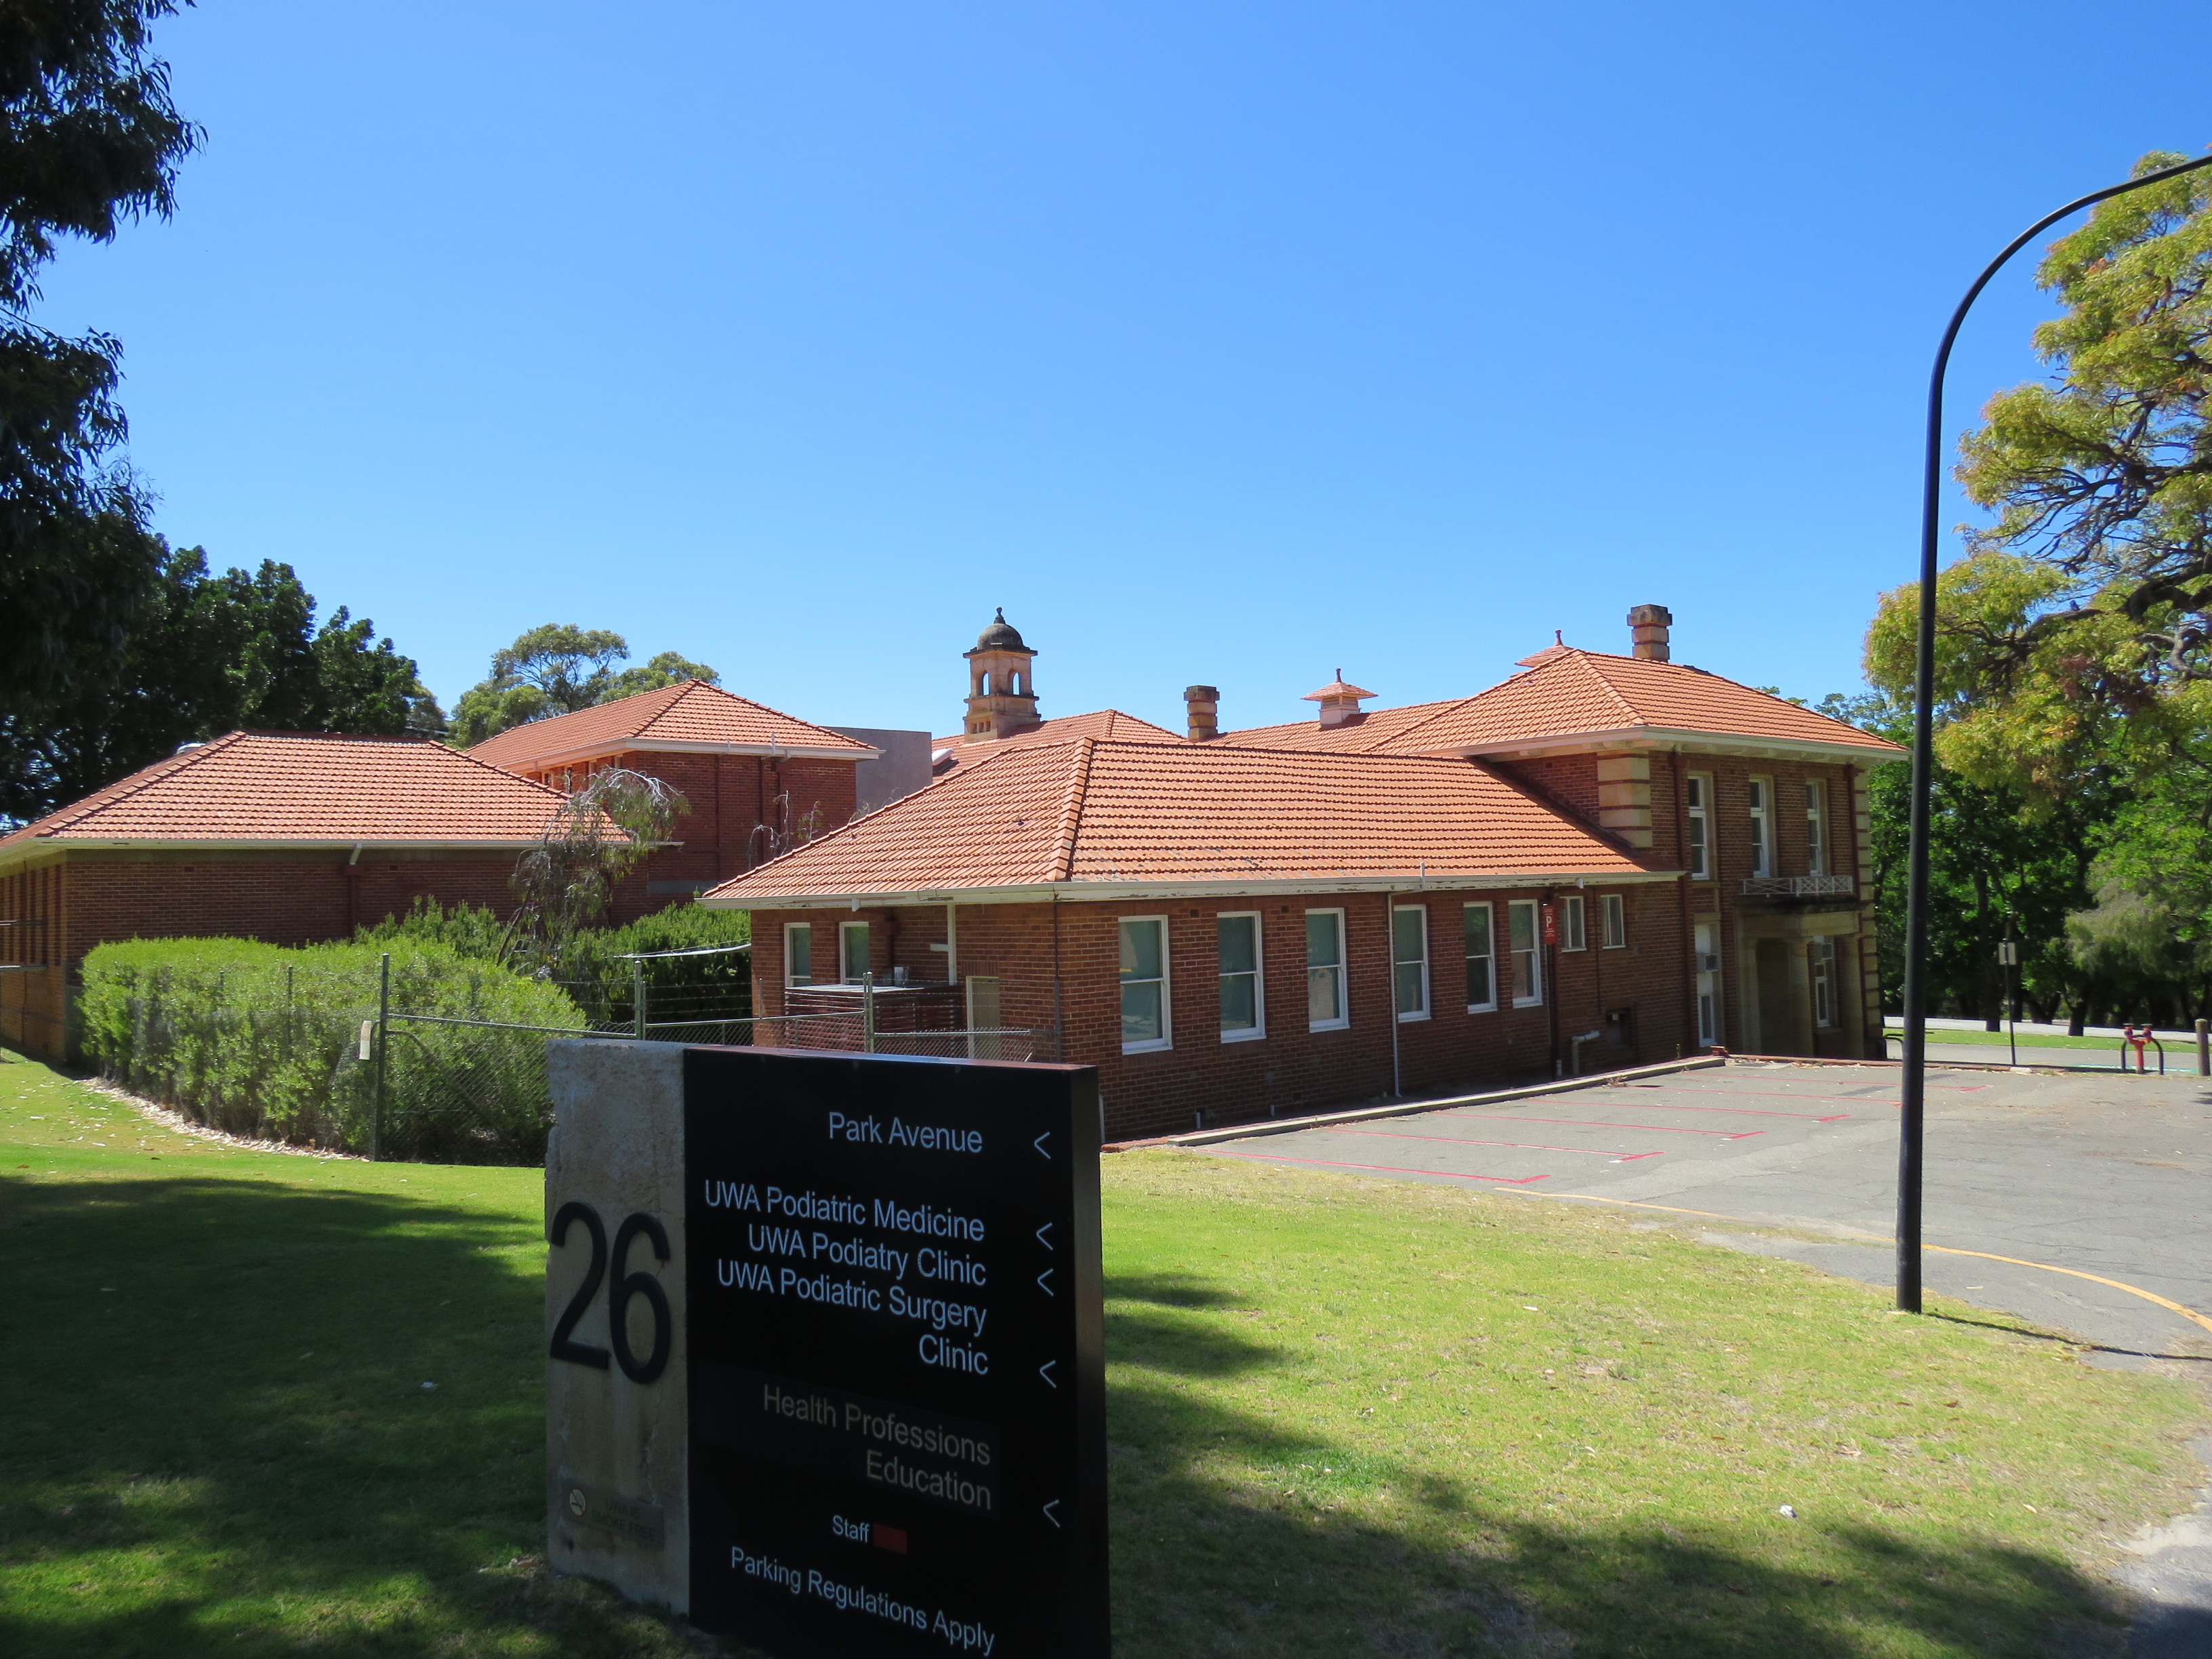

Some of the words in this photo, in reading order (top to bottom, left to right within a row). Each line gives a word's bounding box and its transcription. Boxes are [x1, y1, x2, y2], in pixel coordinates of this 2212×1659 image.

[829, 1111, 882, 1143] Park
[888, 1117, 983, 1153] Avenue
[705, 1179, 761, 1211] UWA
[767, 1186, 866, 1225] Podiatric
[874, 1199, 985, 1242] Medicine
[749, 1223, 806, 1258] UWA
[813, 1232, 909, 1279] Podiatry
[917, 1247, 987, 1286] Clinic
[550, 1202, 672, 1385] 26
[718, 1258, 775, 1294] UWA
[781, 1268, 881, 1311] Podiatric
[888, 1285, 987, 1337] Surgery
[919, 1334, 989, 1375] Clinic
[764, 1385, 836, 1427] Health
[846, 1403, 990, 1465] Professions
[605, 1498, 628, 1515] UWA
[630, 1506, 640, 1520] IS
[867, 1450, 991, 1509] Education
[591, 1510, 626, 1533] SMOKE
[628, 1522, 656, 1542] FREE
[832, 1515, 870, 1542] Staff
[732, 1546, 801, 1594] Parking
[808, 1570, 927, 1629] Regulations
[933, 1610, 995, 1657] Apply
